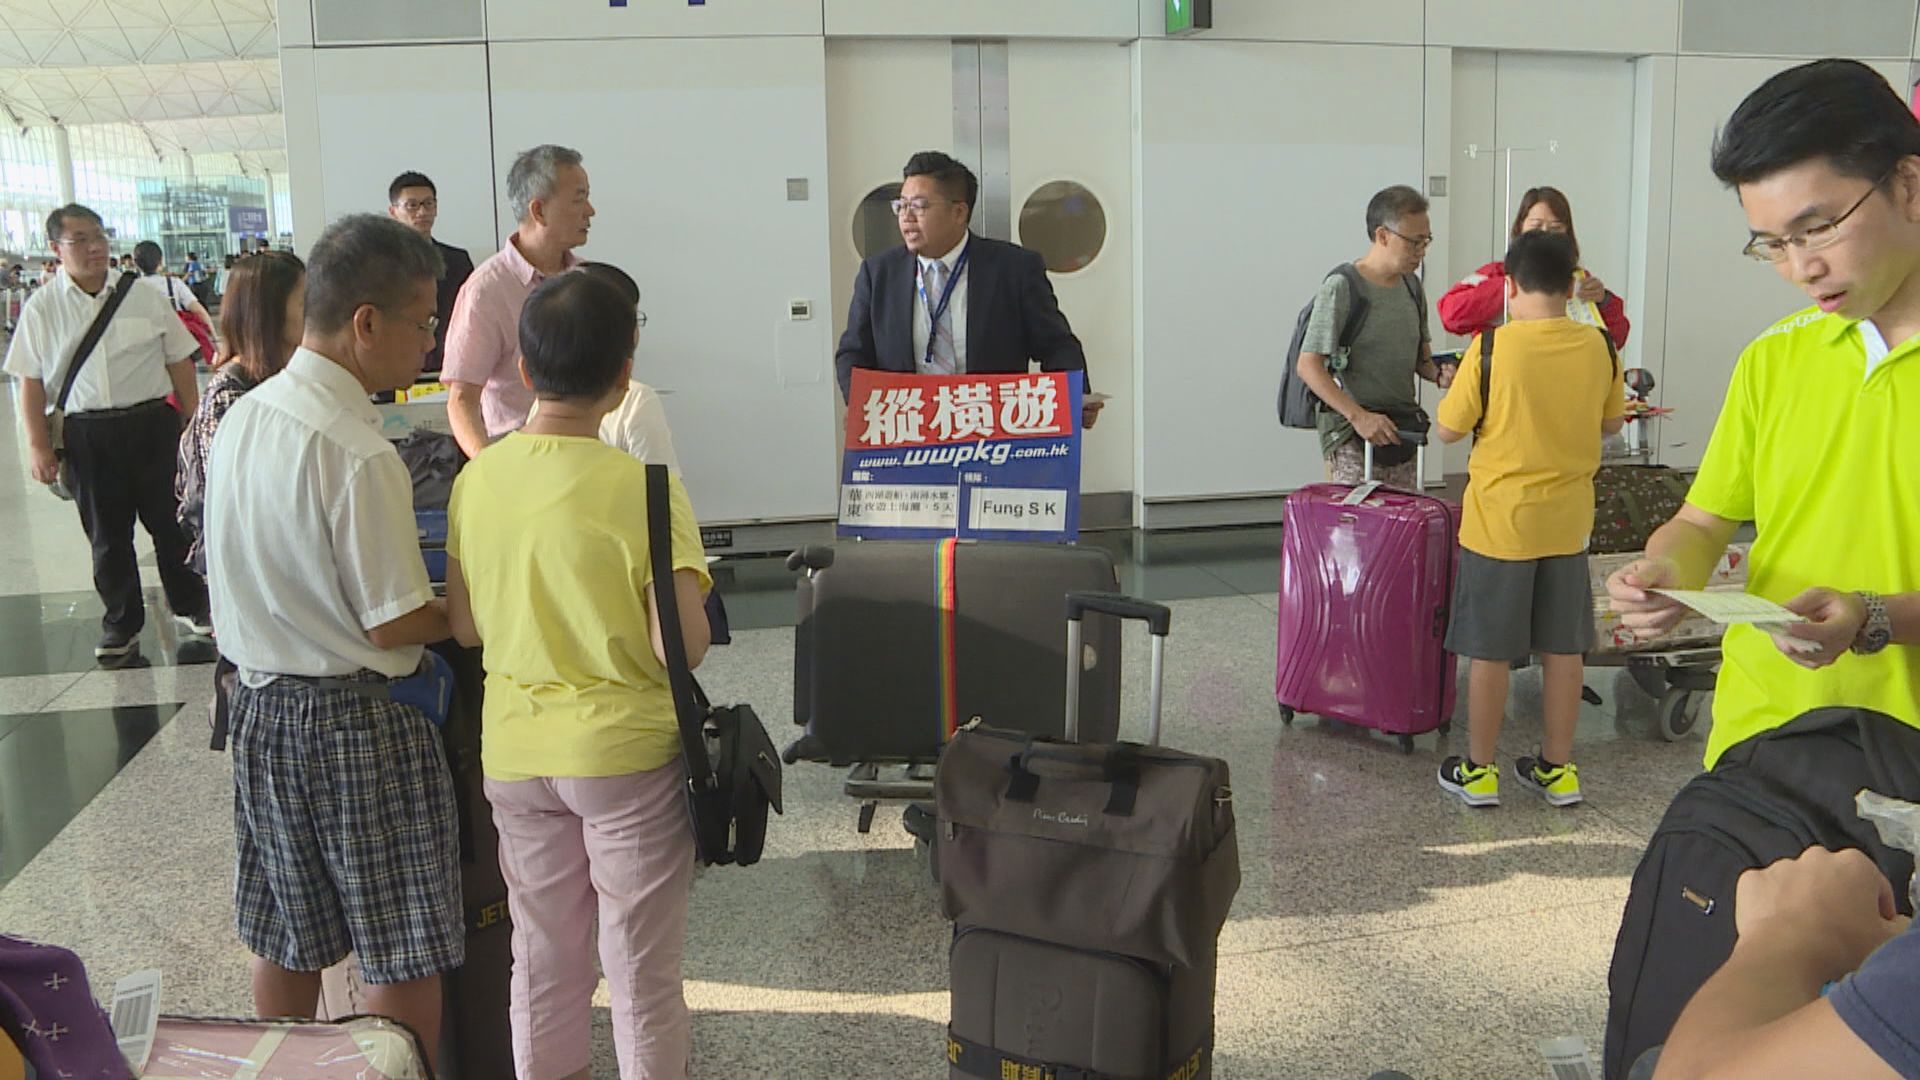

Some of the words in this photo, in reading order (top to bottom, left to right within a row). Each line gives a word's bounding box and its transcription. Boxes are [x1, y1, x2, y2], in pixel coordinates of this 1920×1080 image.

[859, 376, 1060, 445] 縱橫遊
[859, 439, 1069, 467] www.wwpkg.com.hk
[983, 500, 1023, 517] Fung
[1029, 502, 1040, 515] S
[1045, 502, 1057, 515] K
